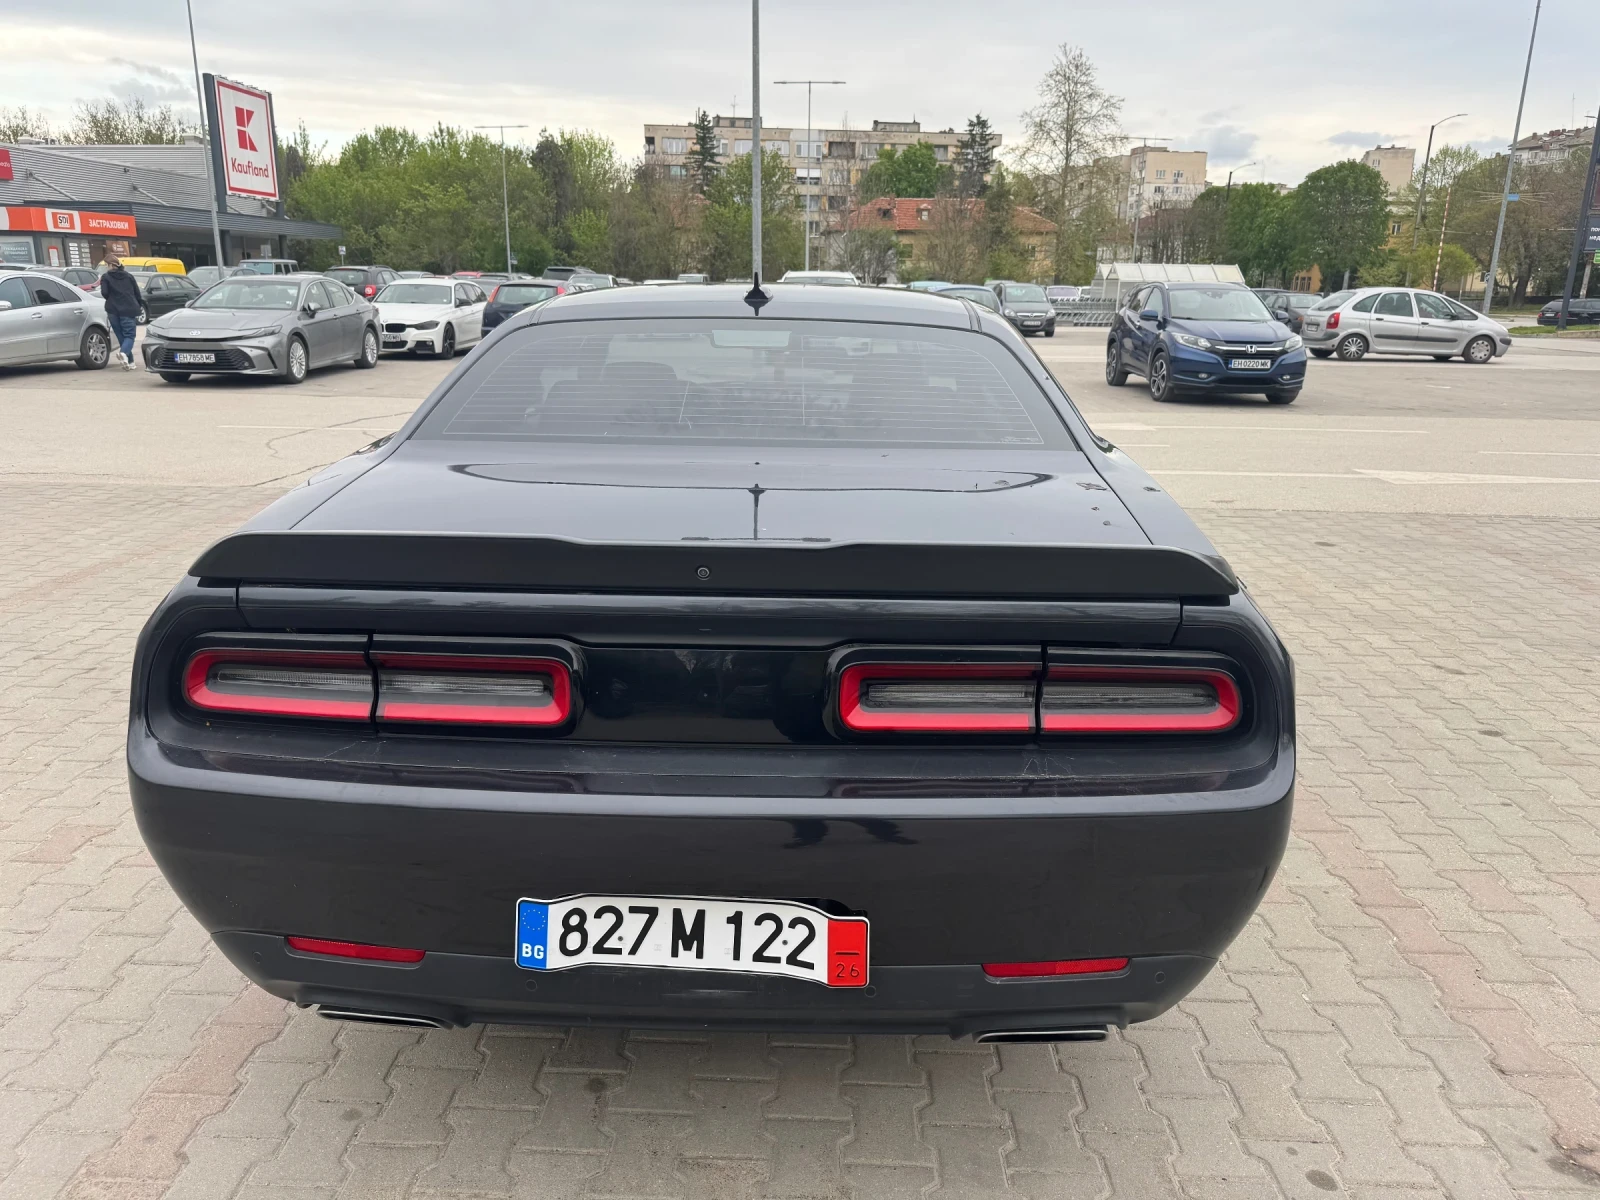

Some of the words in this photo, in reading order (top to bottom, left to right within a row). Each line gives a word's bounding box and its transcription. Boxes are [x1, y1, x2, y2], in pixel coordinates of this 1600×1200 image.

[231, 157, 269, 178] Kaufland
[88, 218, 129, 230] ЗАСТРАХОВКИ
[558, 905, 659, 957] 827
[671, 908, 706, 959] M
[726, 910, 817, 970] 122
[522, 943, 544, 960] BG
[836, 962, 860, 978] 26
